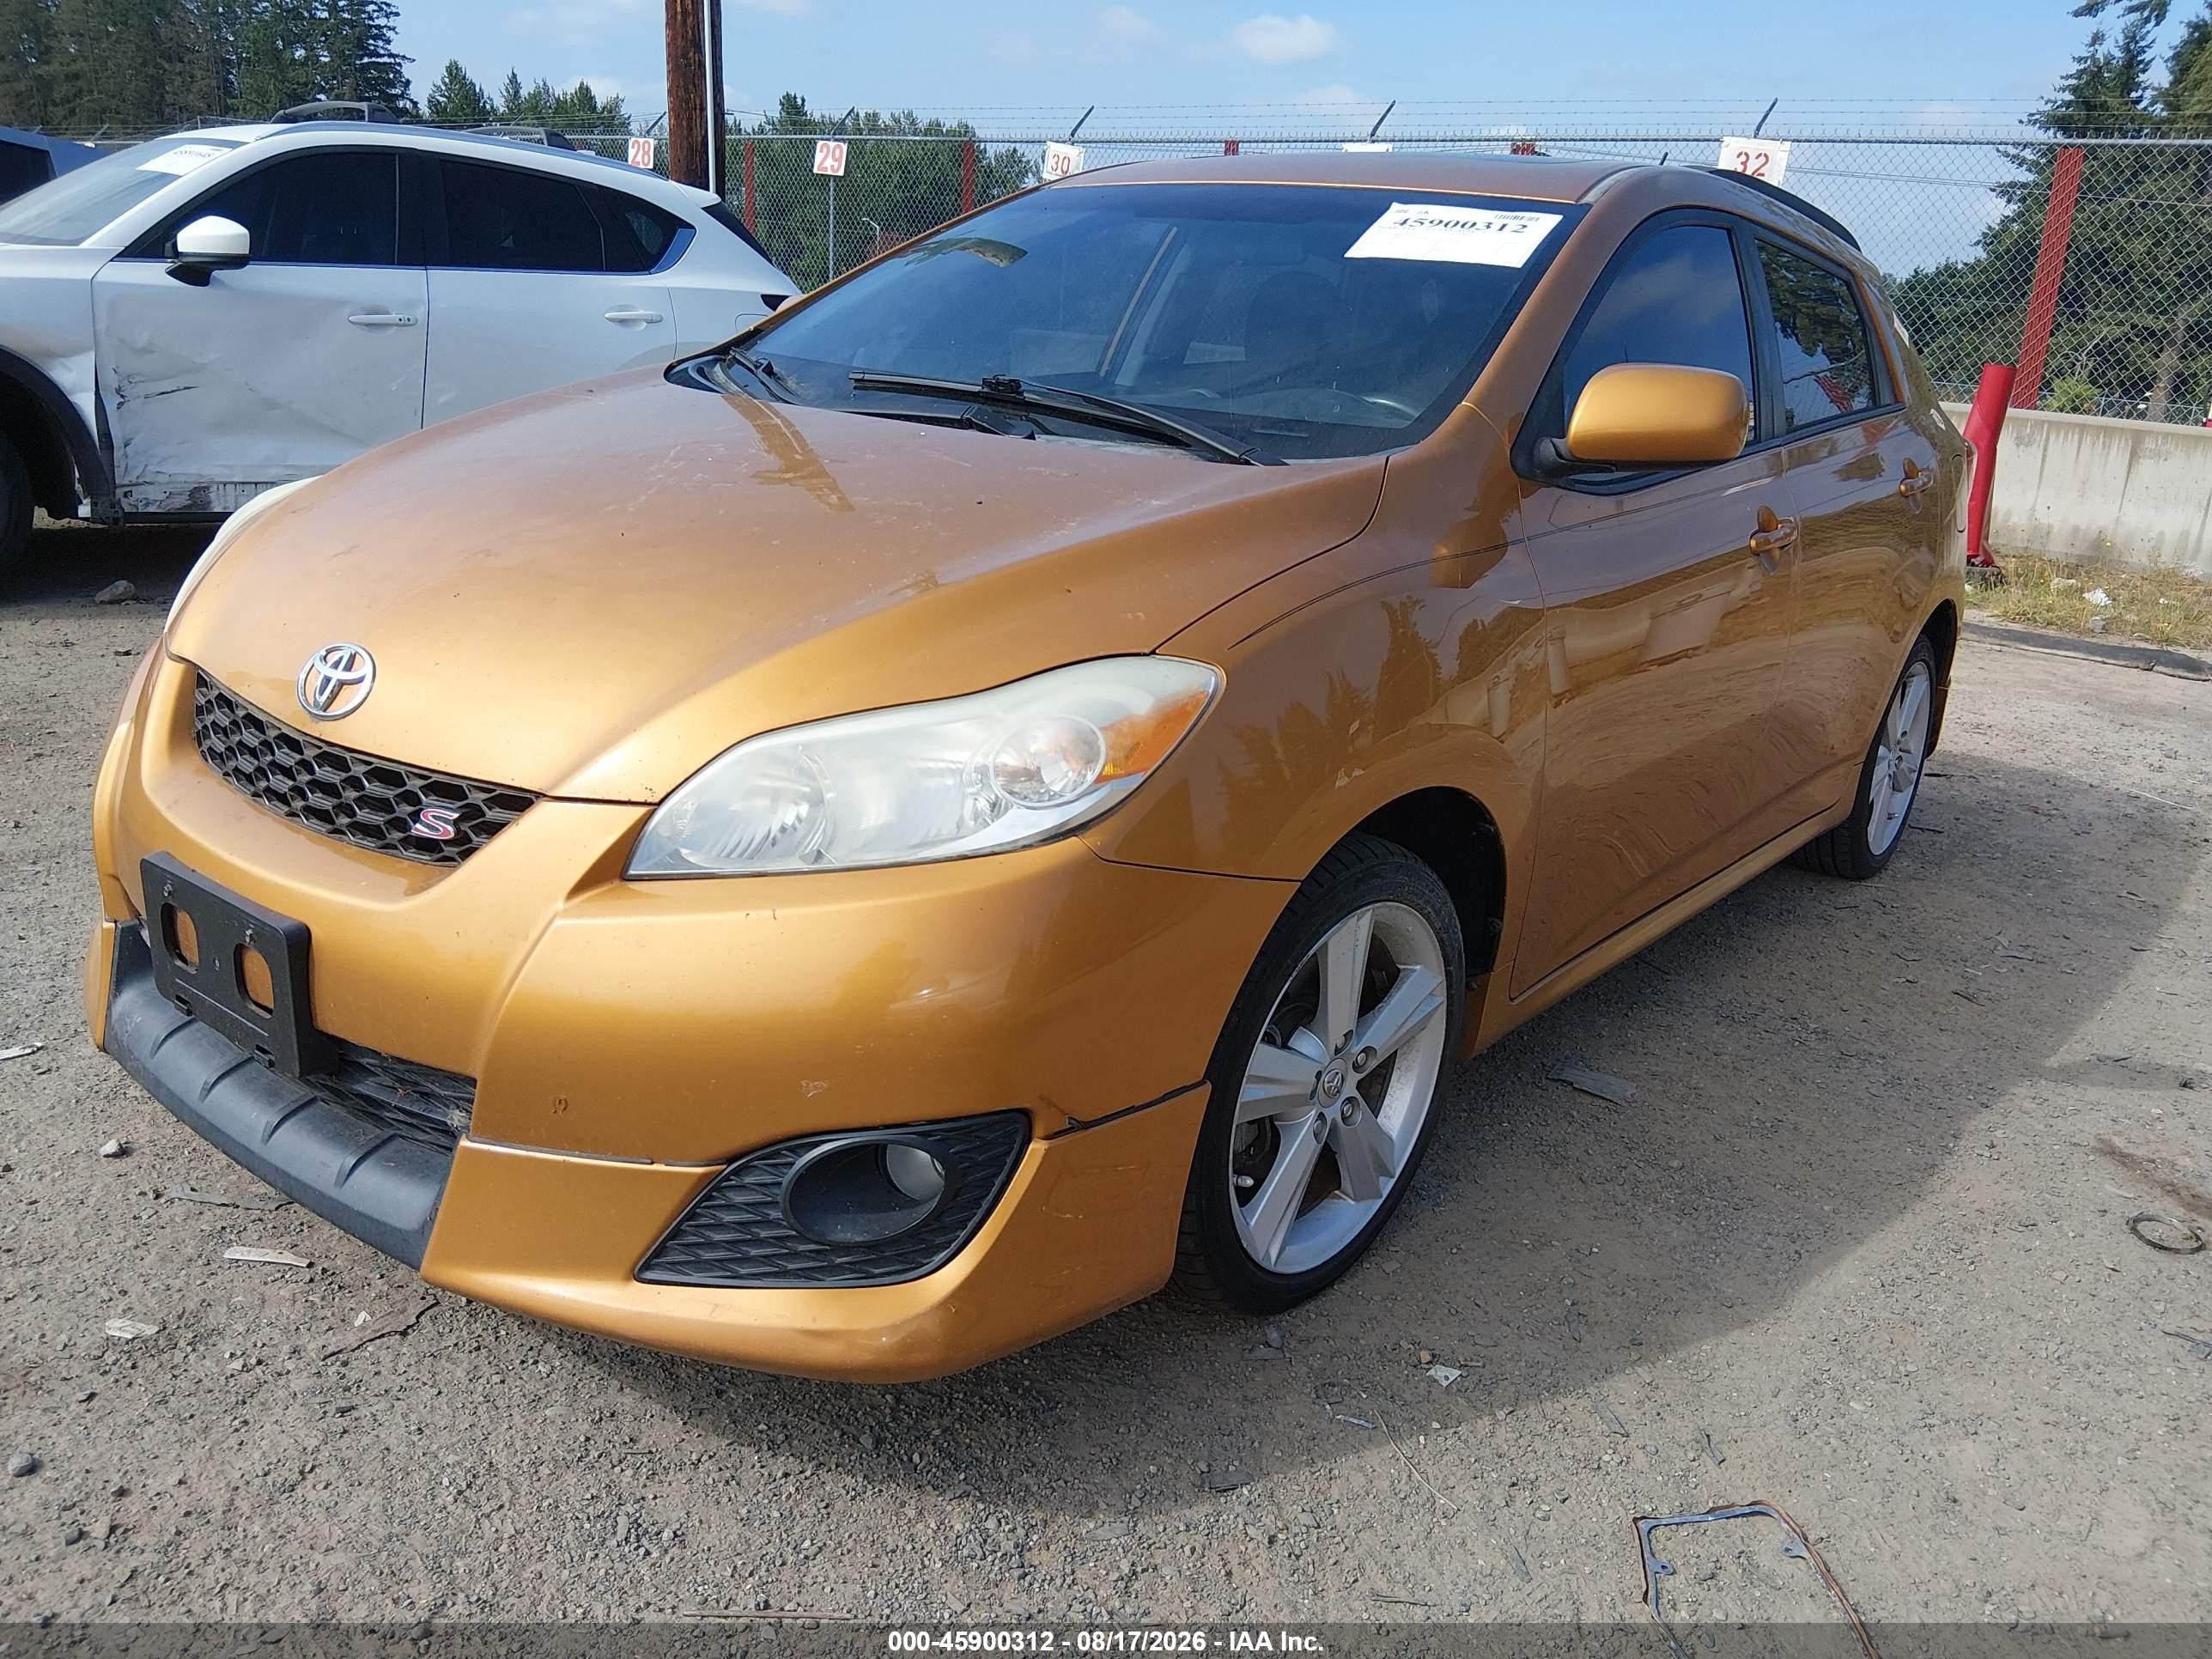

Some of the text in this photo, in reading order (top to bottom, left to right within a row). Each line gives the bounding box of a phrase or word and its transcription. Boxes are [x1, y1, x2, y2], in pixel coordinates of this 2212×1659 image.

[631, 139, 651, 167] 28
[817, 143, 844, 173] 29
[1050, 153, 1071, 176] 30
[1734, 150, 1770, 177] 32
[1392, 217, 1528, 234] 45900312
[410, 807, 461, 840] S
